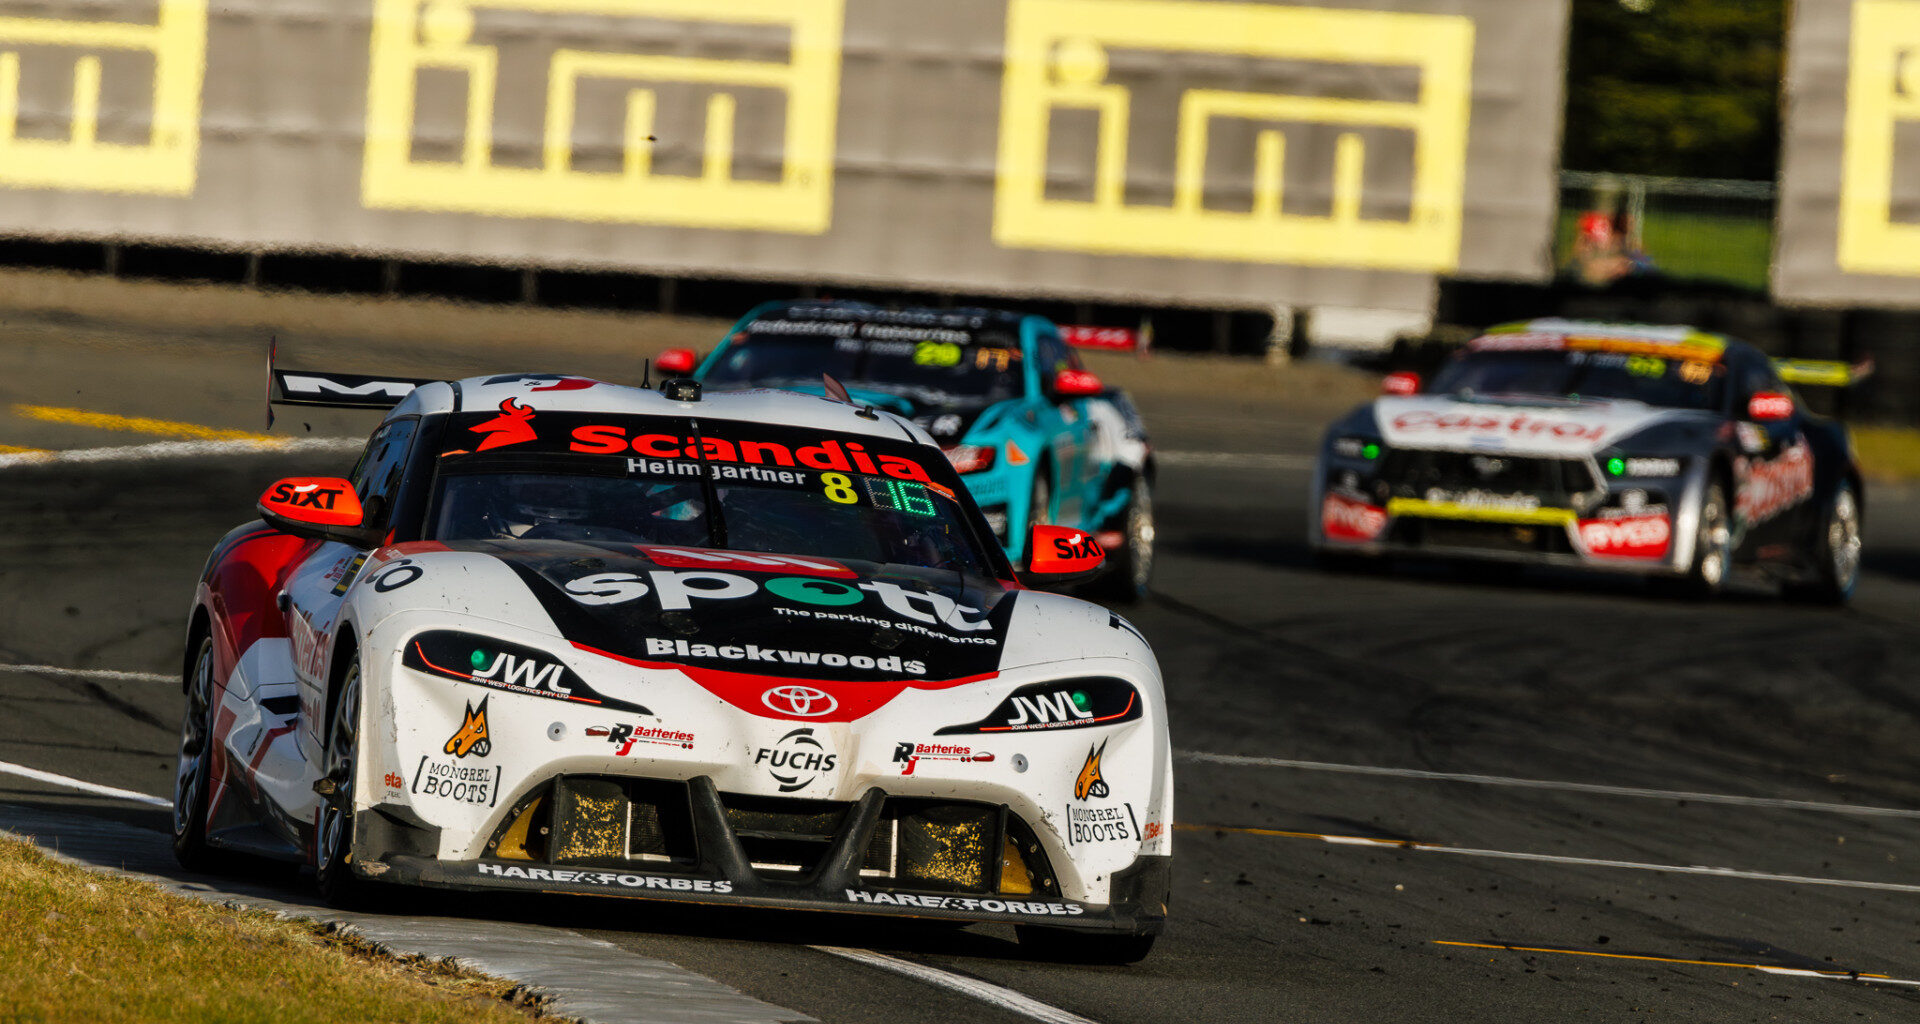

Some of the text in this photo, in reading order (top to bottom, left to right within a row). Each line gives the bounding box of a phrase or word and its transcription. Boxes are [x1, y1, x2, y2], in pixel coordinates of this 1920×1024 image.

[570, 425, 932, 482] Scandia
[628, 458, 806, 485] Heimgartner
[820, 472, 859, 504] 8
[564, 570, 993, 631] spott
[773, 606, 998, 646] The parking difference
[646, 637, 927, 676] Blackwoods
[471, 652, 572, 695] JWL
[471, 676, 488, 684] JOHN
[488, 679, 507, 688] WEST
[507, 683, 541, 695] LOGISTICS
[541, 690, 556, 698] PTY
[1008, 690, 1094, 725] JWL
[634, 726, 694, 741] Batteries
[755, 747, 837, 772] FUCHS
[915, 743, 971, 755] Batteries
[429, 762, 491, 782] MONGREL
[423, 776, 487, 803] BOOTS
[1072, 808, 1124, 822] MONGREL
[1074, 822, 1129, 843] BOOTS
